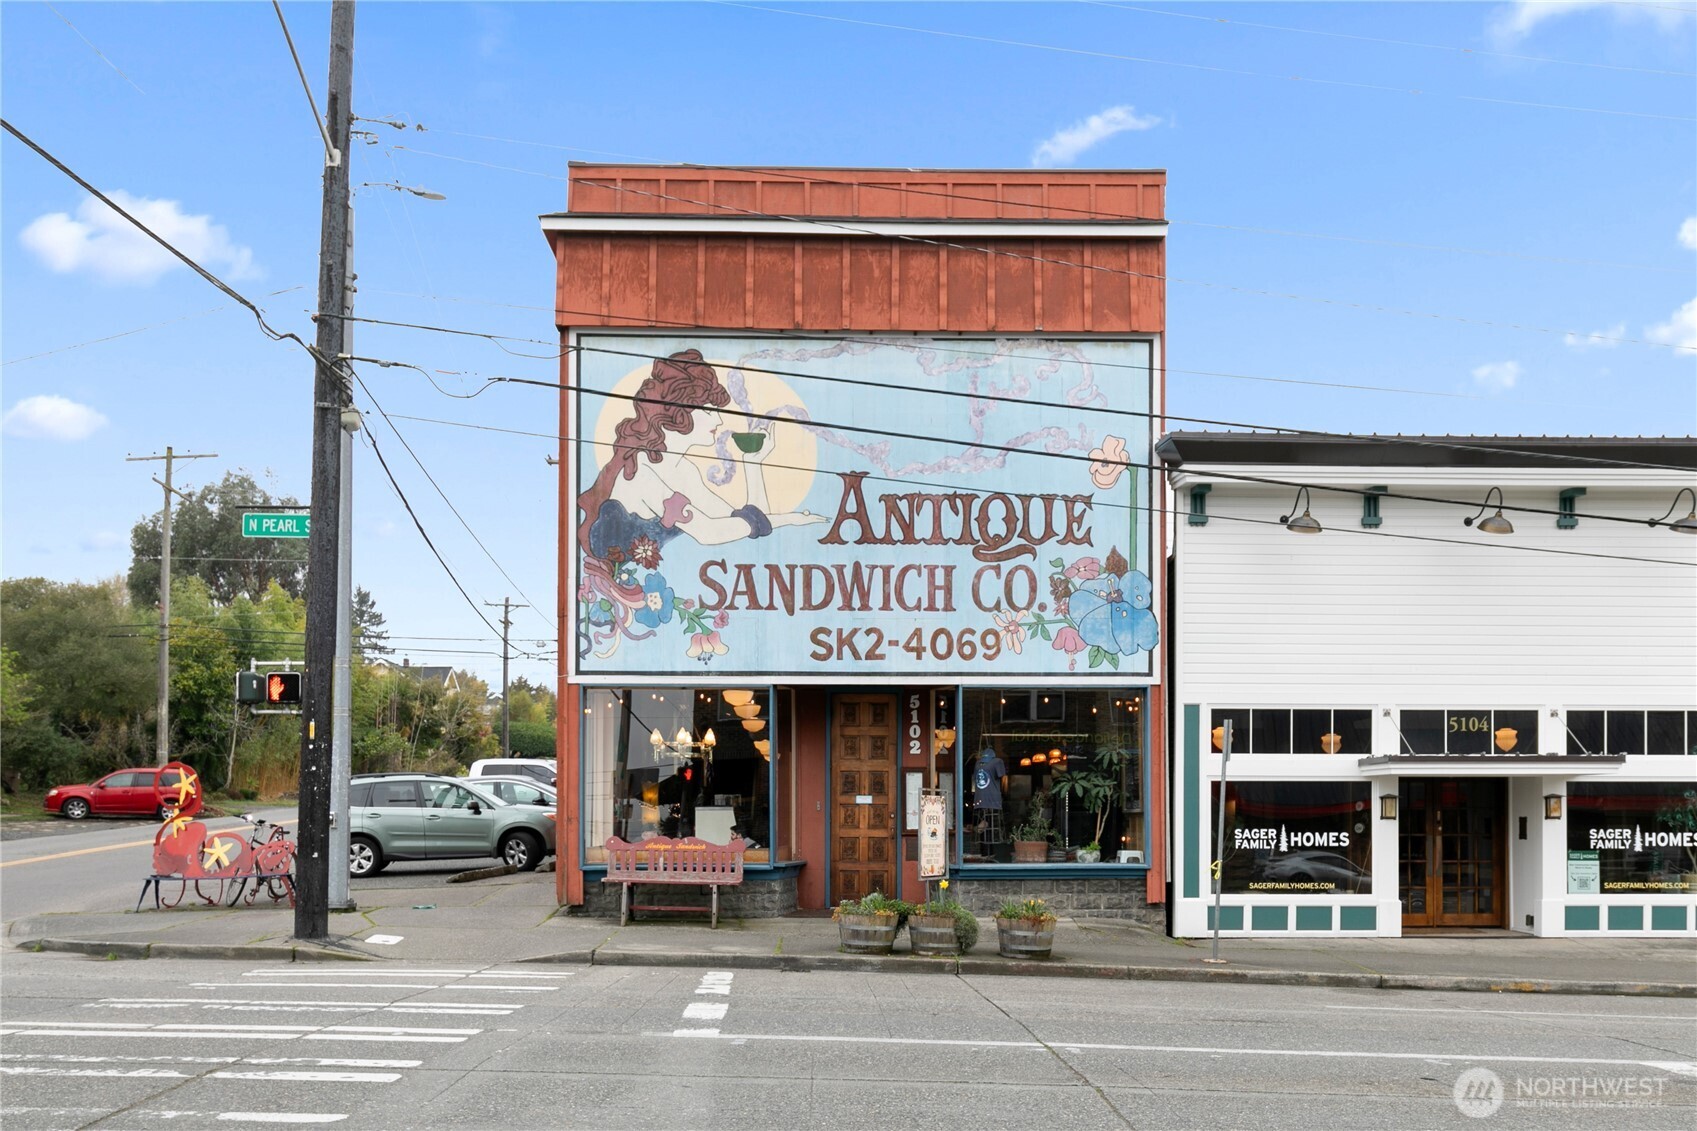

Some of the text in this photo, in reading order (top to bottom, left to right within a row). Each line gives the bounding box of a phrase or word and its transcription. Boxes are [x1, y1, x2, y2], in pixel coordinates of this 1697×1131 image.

[817, 471, 1095, 563] ANTIQUE
[249, 519, 310, 532] N PEARL S
[697, 558, 1048, 615] SANDWICH CO.
[809, 626, 1002, 662] SK2-4069
[909, 694, 921, 755] 5102
[1449, 715, 1489, 732] 5104
[926, 814, 940, 825] OPEN
[1234, 828, 1277, 839] SAGER
[1290, 831, 1350, 847] HOMES
[1589, 828, 1632, 839] SAGER
[645, 842, 706, 850] Antique Sandwich
[1235, 839, 1277, 849] FAMILY
[1590, 839, 1632, 849] FAMILY
[1249, 882, 1335, 890] SAGERFAMILYHOMES.COM
